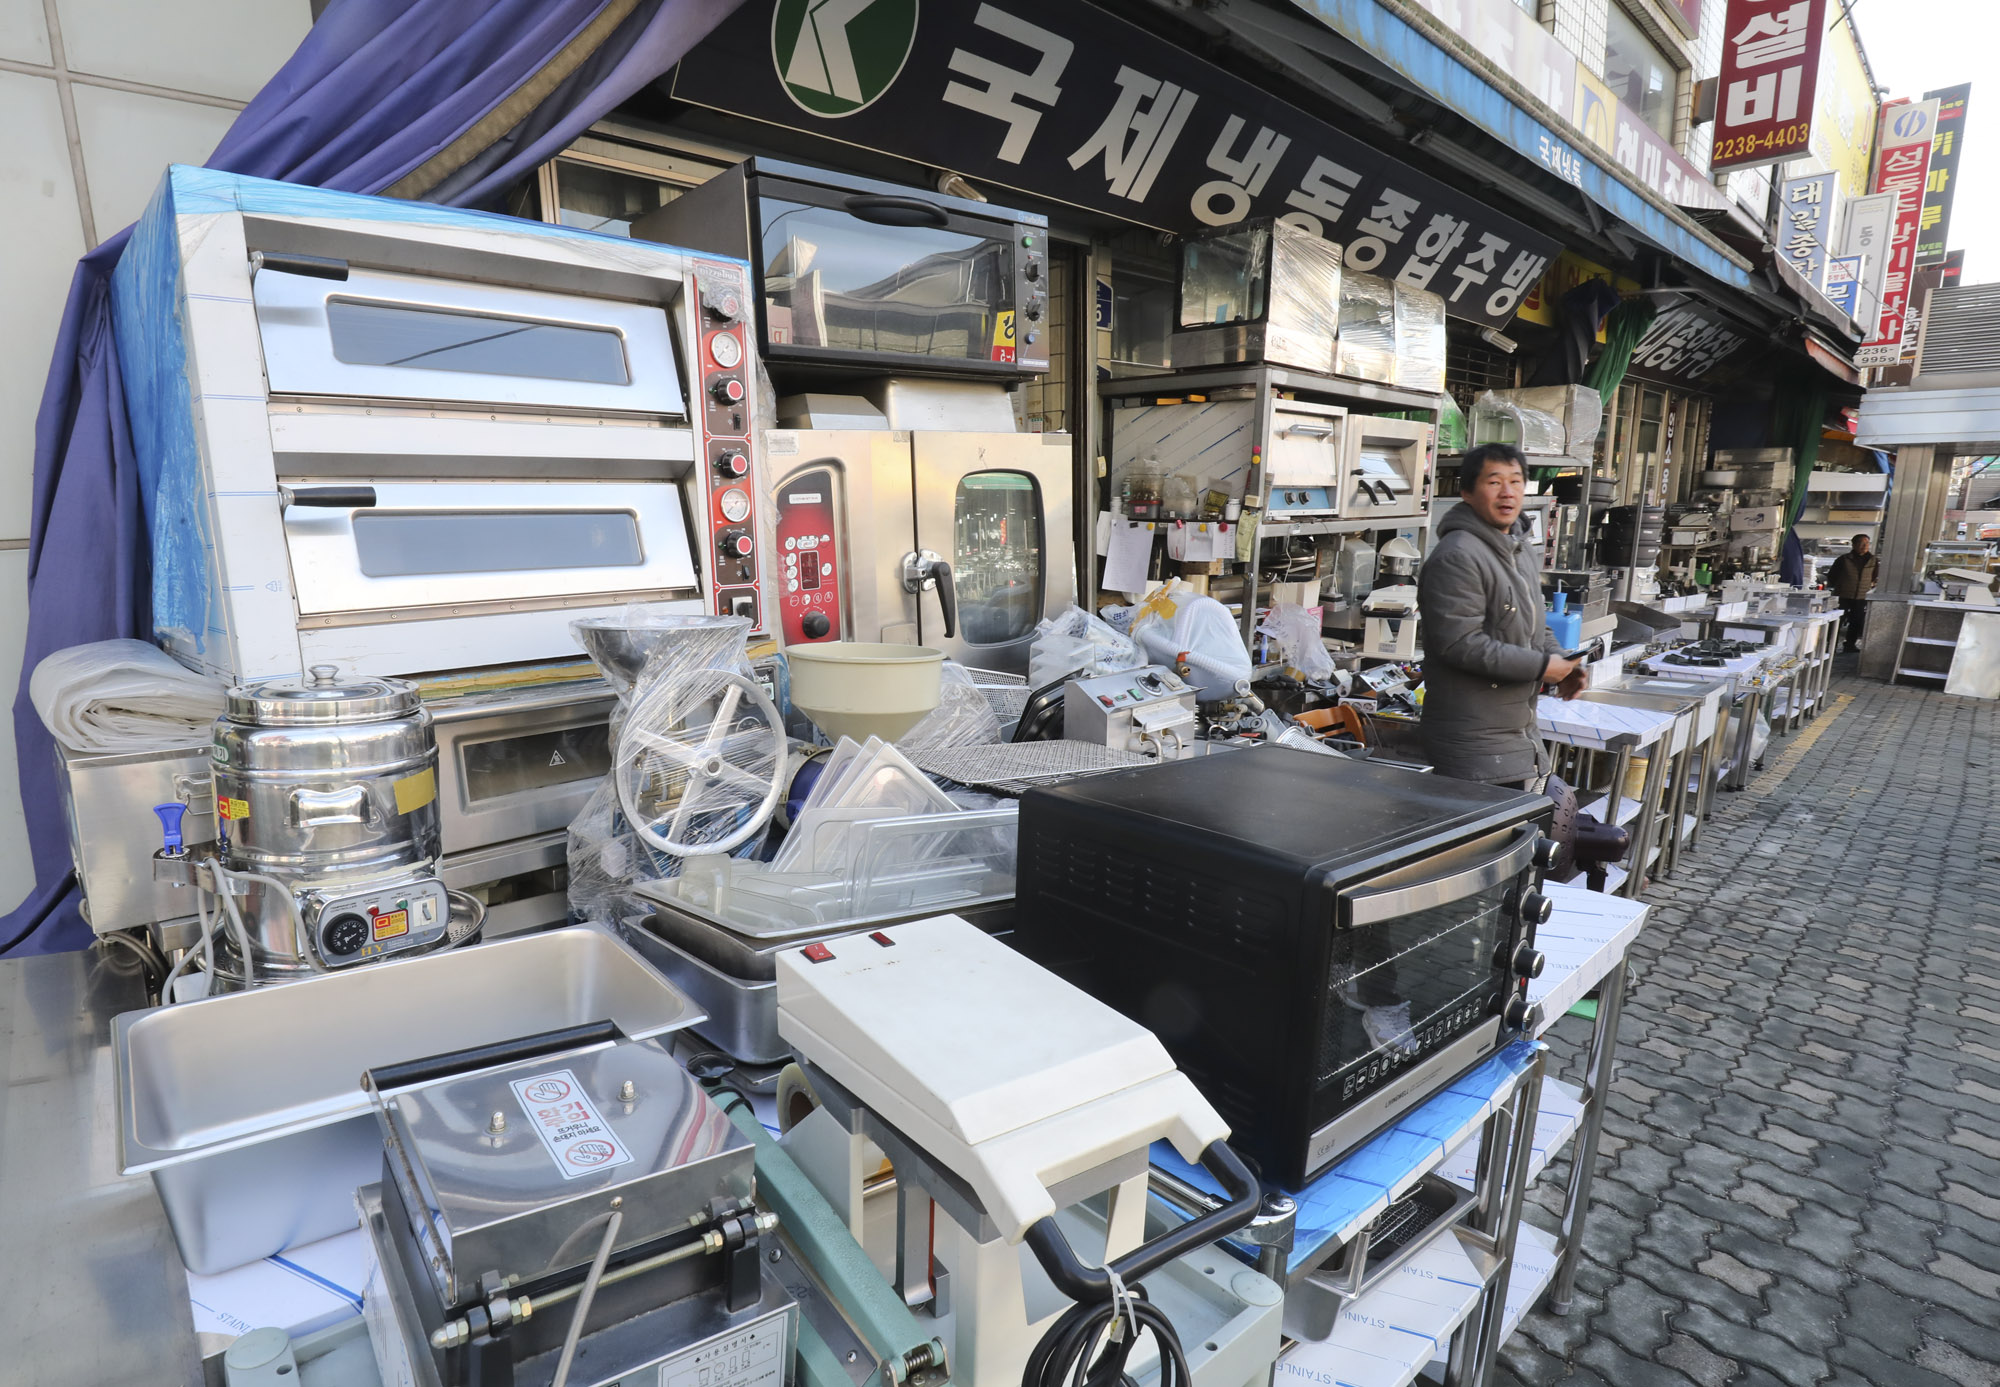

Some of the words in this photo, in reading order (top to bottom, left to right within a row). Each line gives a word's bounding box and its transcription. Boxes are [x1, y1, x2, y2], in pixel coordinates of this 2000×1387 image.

[1713, 123, 1809, 160] 2238-4403
[1539, 135, 1582, 188] 국제냉동
[1861, 356, 1895, 364] 9959
[361, 943, 385, 957] HY
[553, 1131, 577, 1143] 손대지
[577, 1126, 602, 1137] 마세요
[557, 1122, 588, 1134] 뜨거우니
